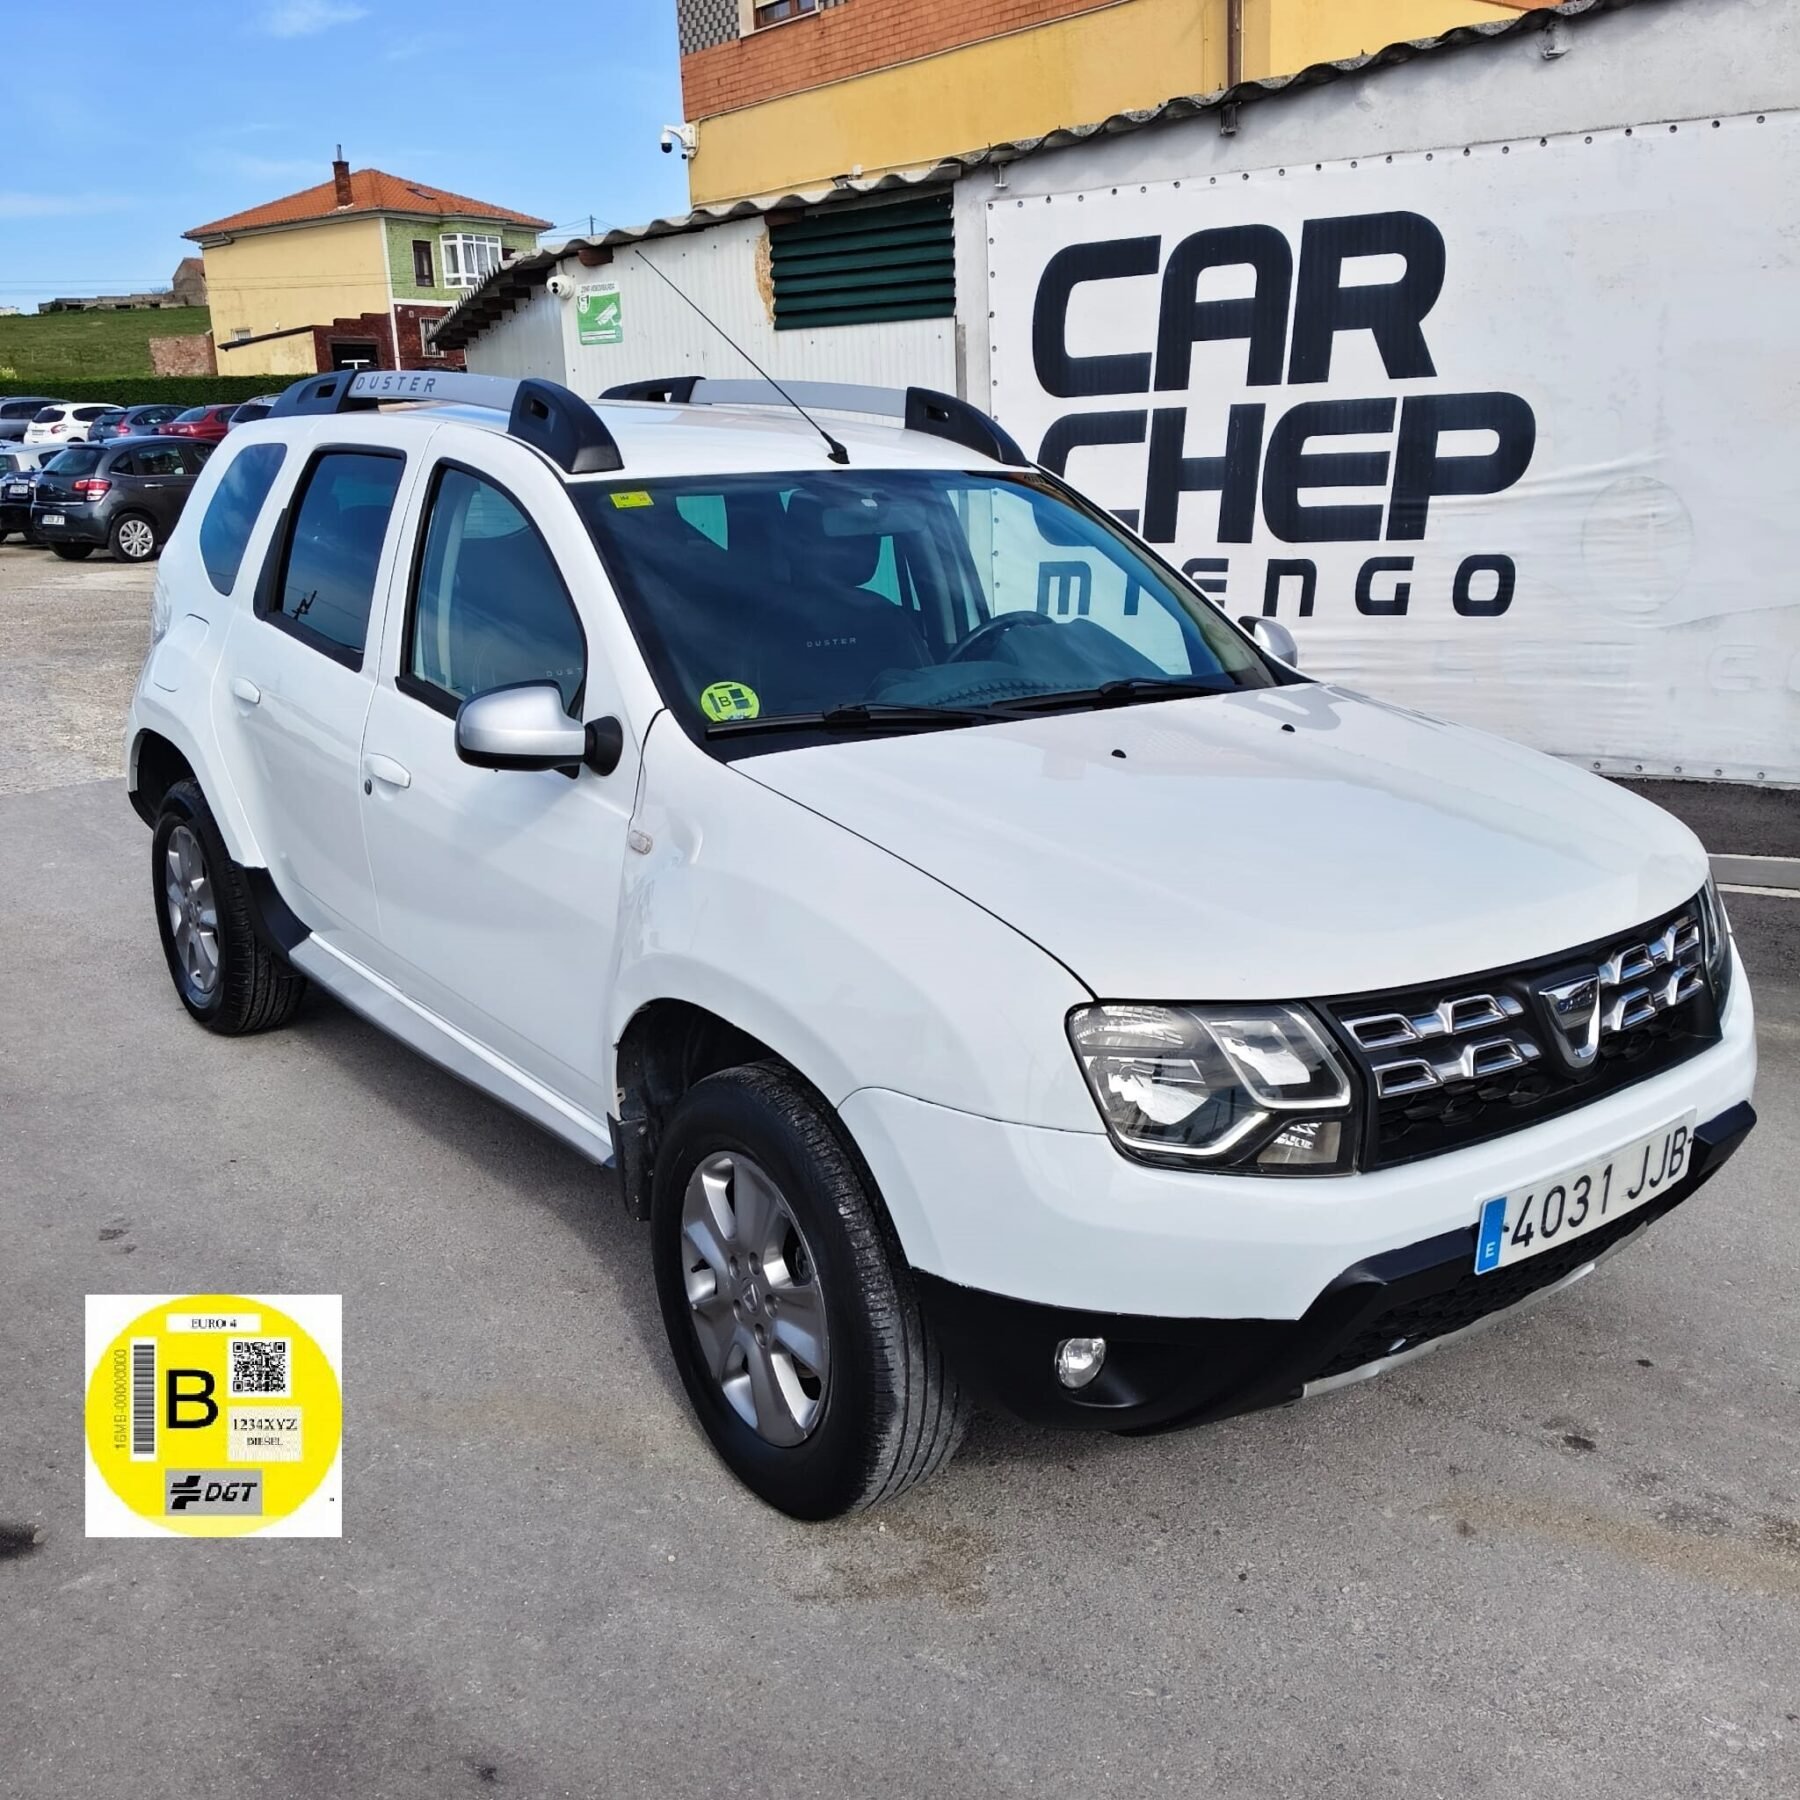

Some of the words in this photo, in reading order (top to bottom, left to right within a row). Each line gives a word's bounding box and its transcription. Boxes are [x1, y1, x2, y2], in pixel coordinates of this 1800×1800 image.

[1032, 210, 1446, 399] CAR
[356, 375, 436, 393] DUSTER
[1033, 391, 1537, 548] CHEP
[718, 696, 732, 707] B
[1510, 1163, 1613, 1247] 4031
[1627, 1125, 1689, 1200] JJB
[1484, 1241, 1497, 1259] E
